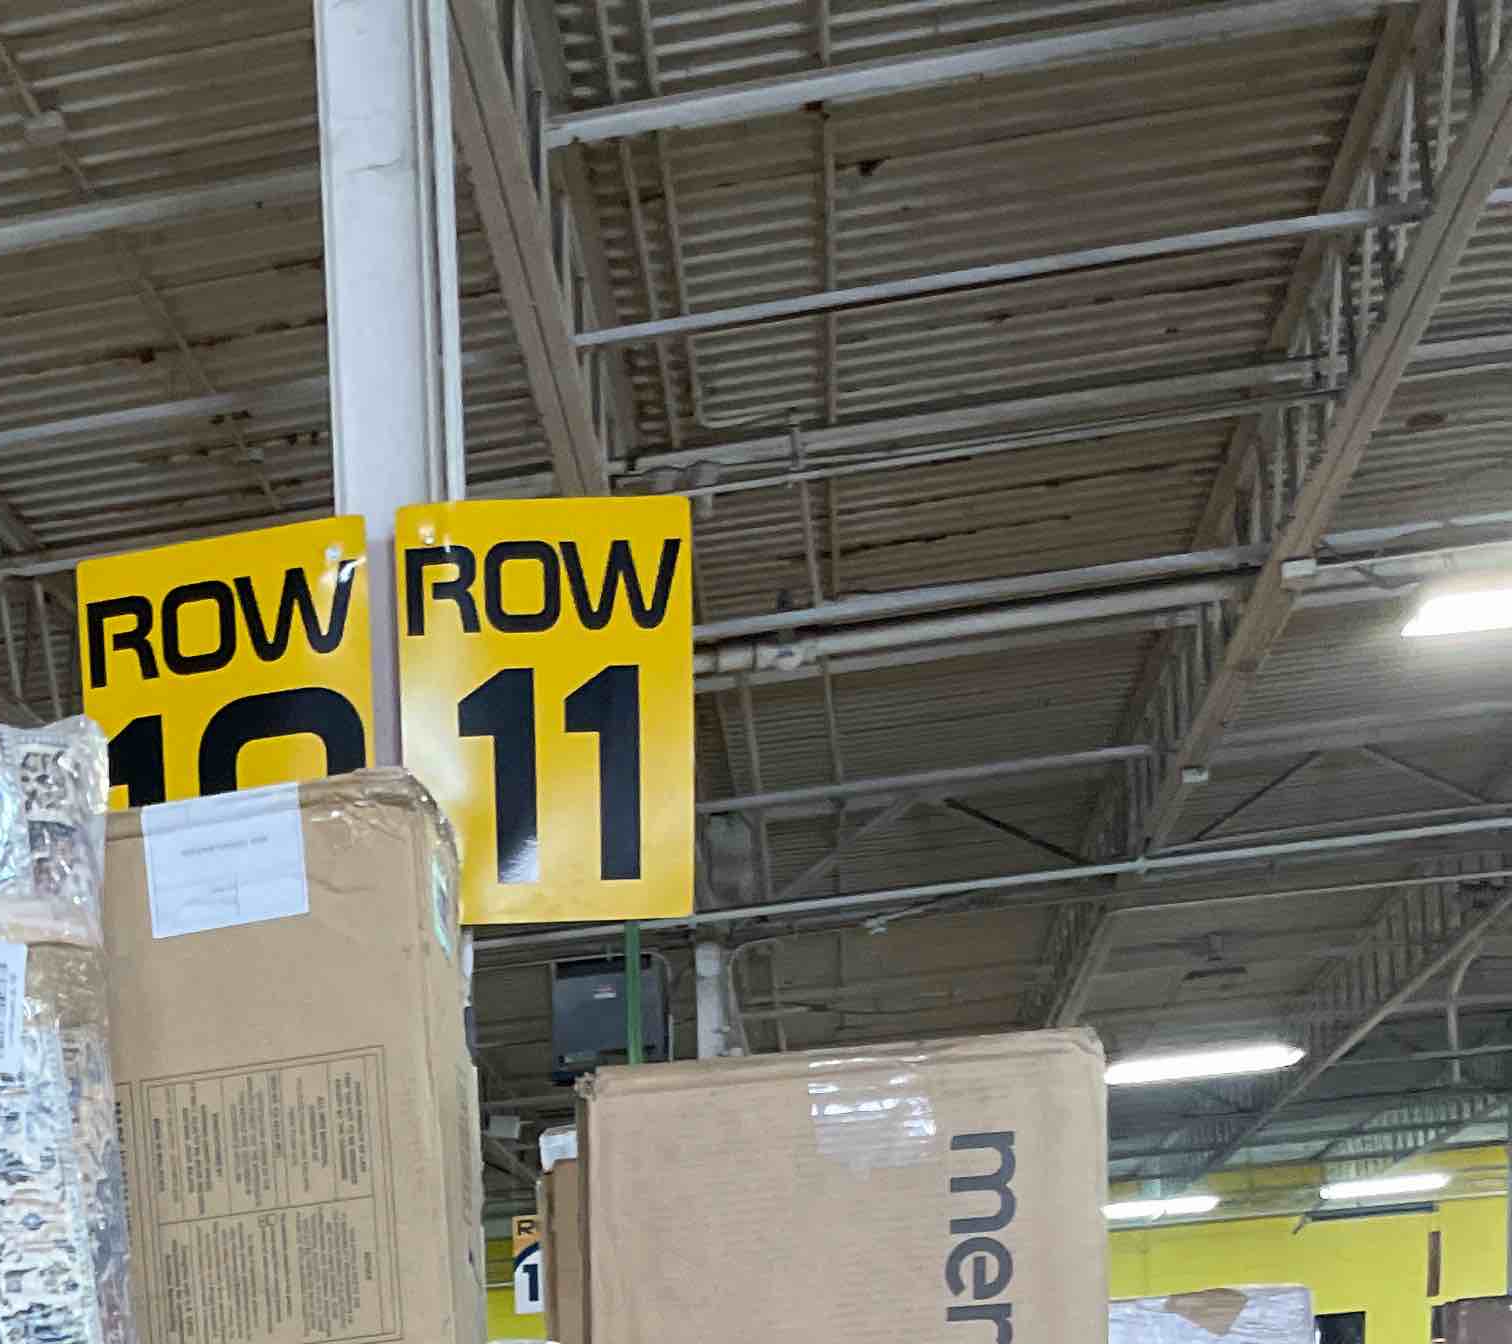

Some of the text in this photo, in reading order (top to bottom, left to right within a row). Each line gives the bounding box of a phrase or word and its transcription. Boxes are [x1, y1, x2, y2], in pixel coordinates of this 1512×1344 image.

[86, 559, 354, 689] ROW
[403, 538, 681, 637] ROW
[456, 664, 641, 884] 11
